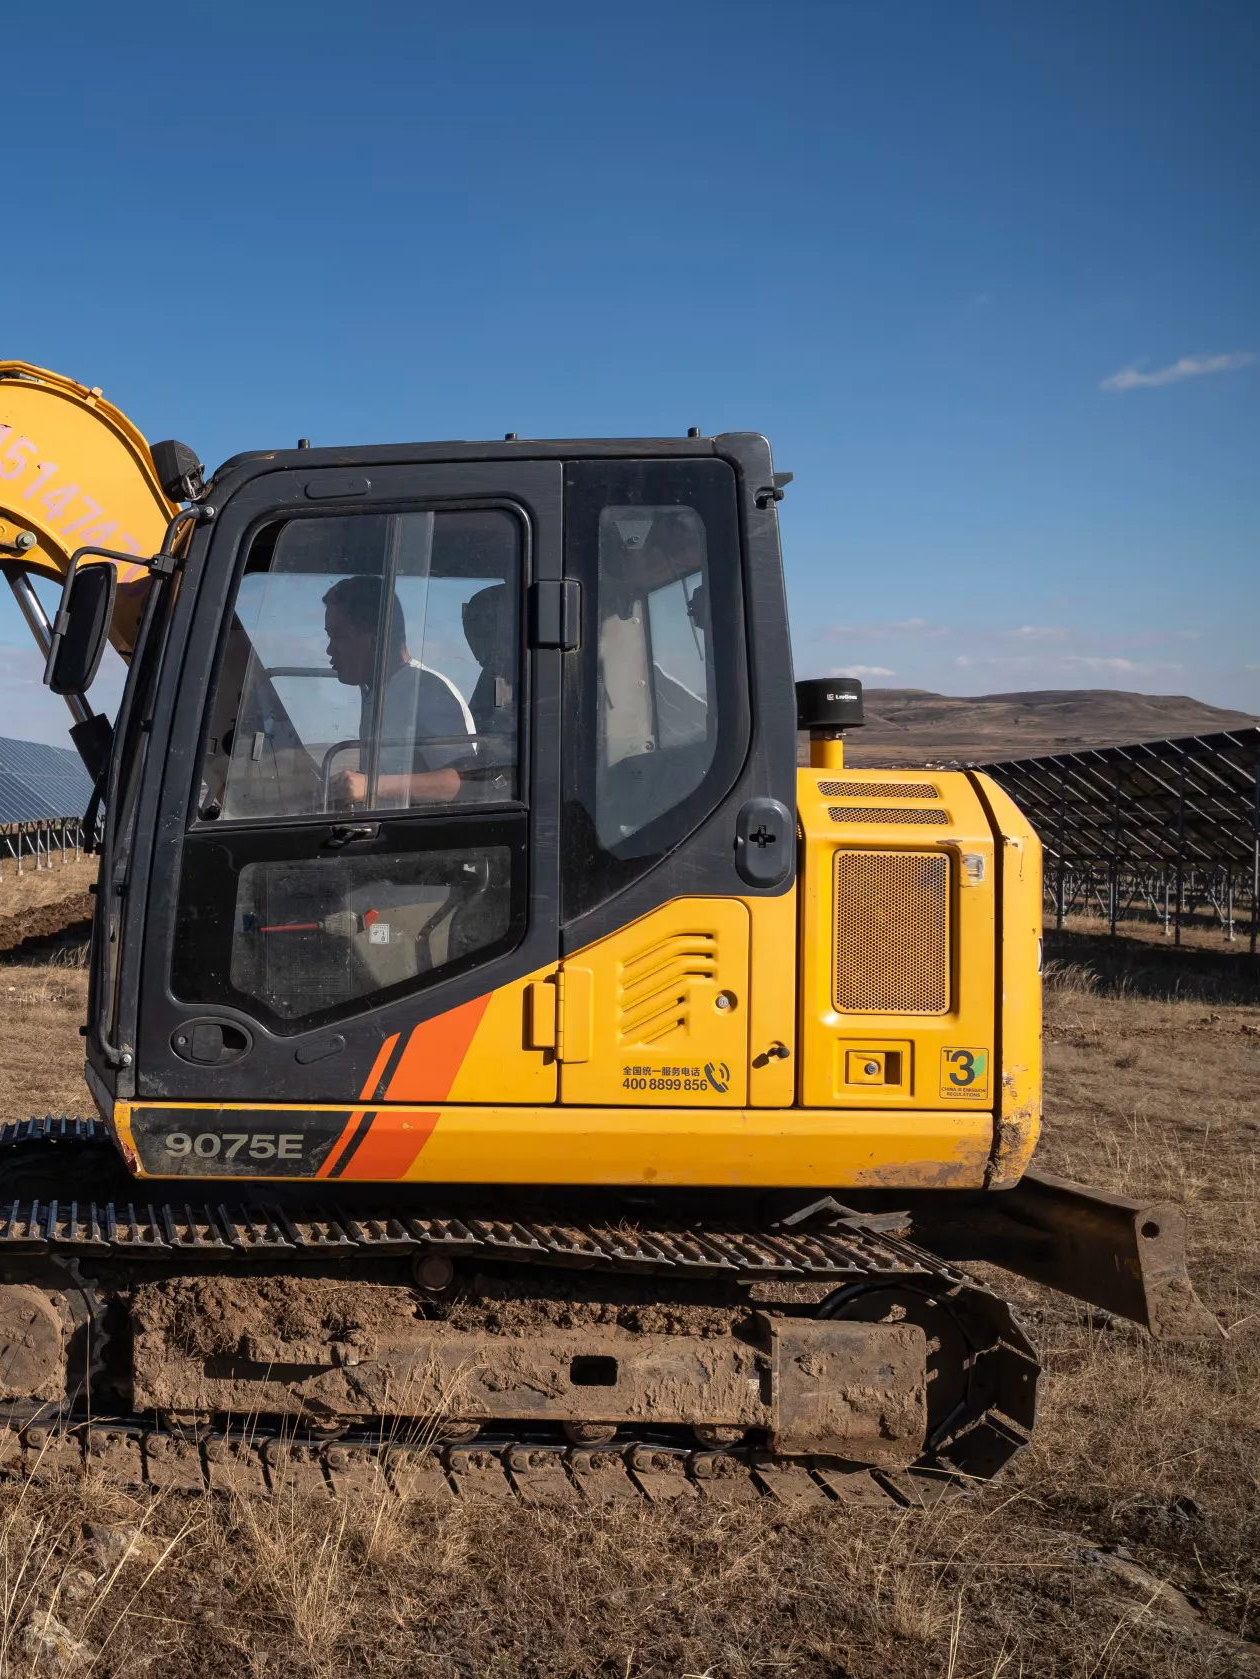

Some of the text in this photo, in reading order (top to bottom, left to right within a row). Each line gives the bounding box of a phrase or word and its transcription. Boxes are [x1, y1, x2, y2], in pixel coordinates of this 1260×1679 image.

[623, 1066, 700, 1077] 全国统一服务电话
[622, 1078, 708, 1091] 400 8899 856
[165, 1133, 304, 1159] 9075E
